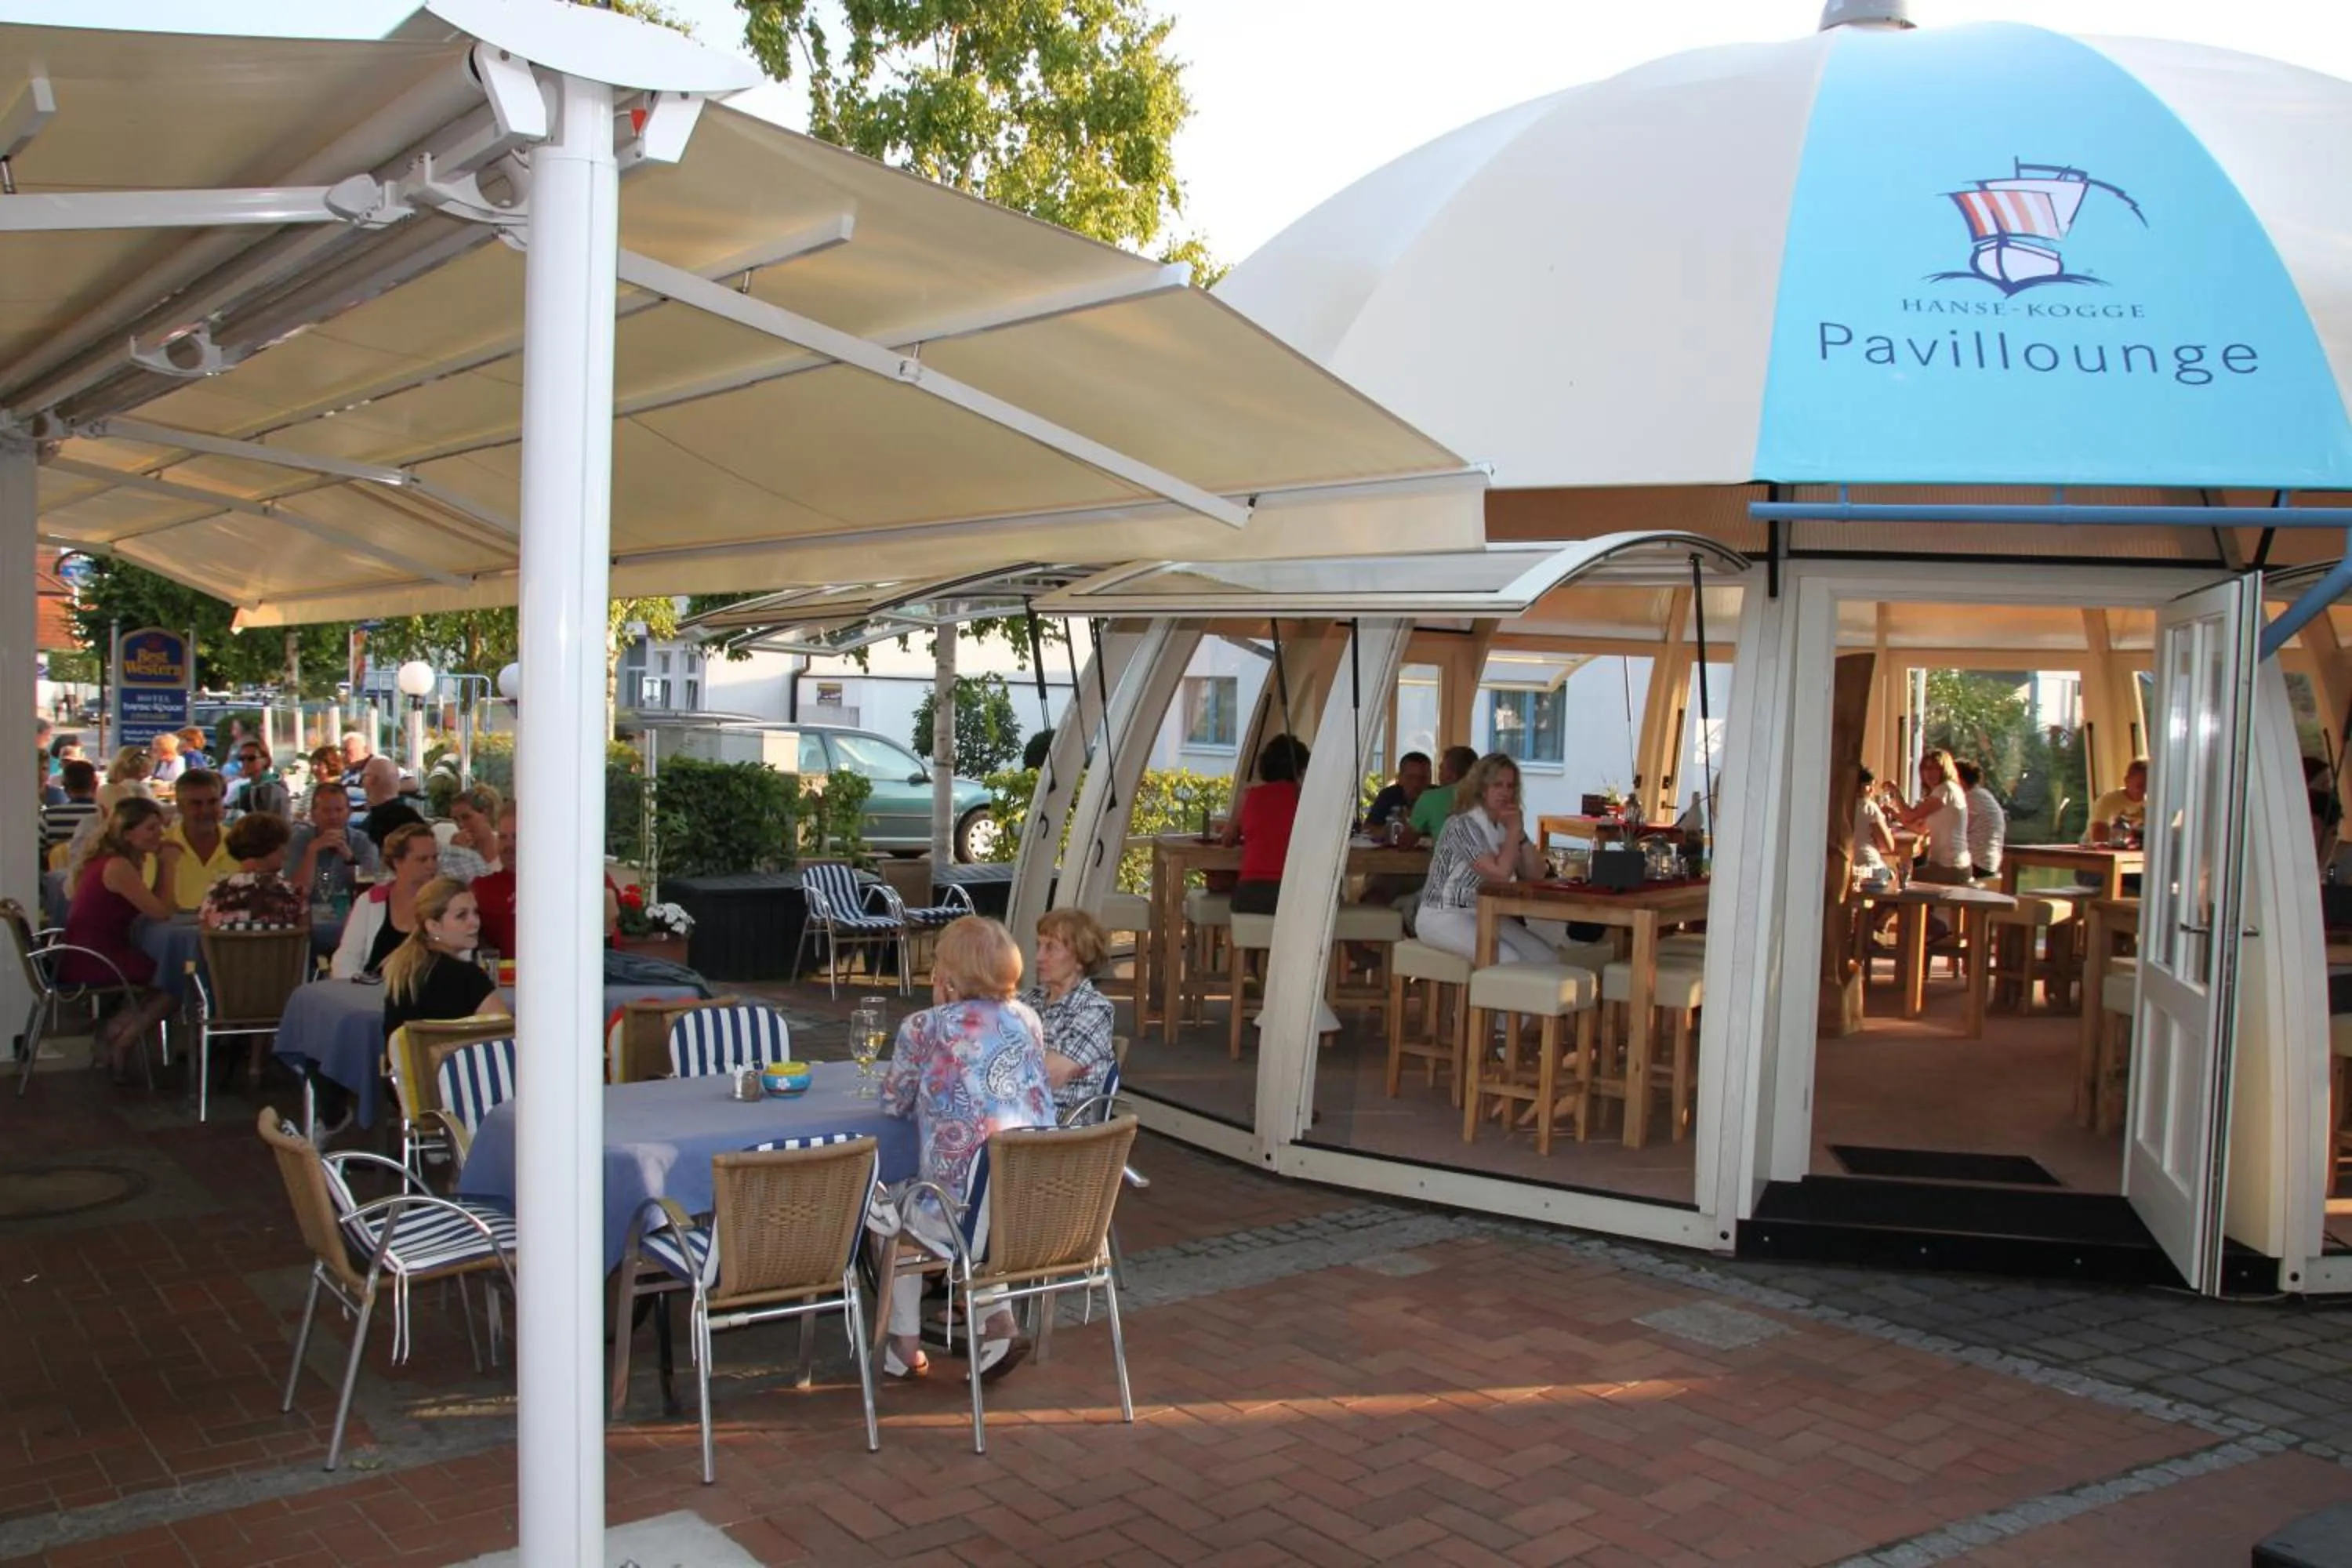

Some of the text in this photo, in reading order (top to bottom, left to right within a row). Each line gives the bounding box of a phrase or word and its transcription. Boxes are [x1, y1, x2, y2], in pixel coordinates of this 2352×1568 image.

[1902, 299, 2145, 318] HANSE-KOGGE
[1819, 322, 2259, 385] Pavillounge
[137, 649, 168, 662] Best
[125, 660, 183, 675] Western
